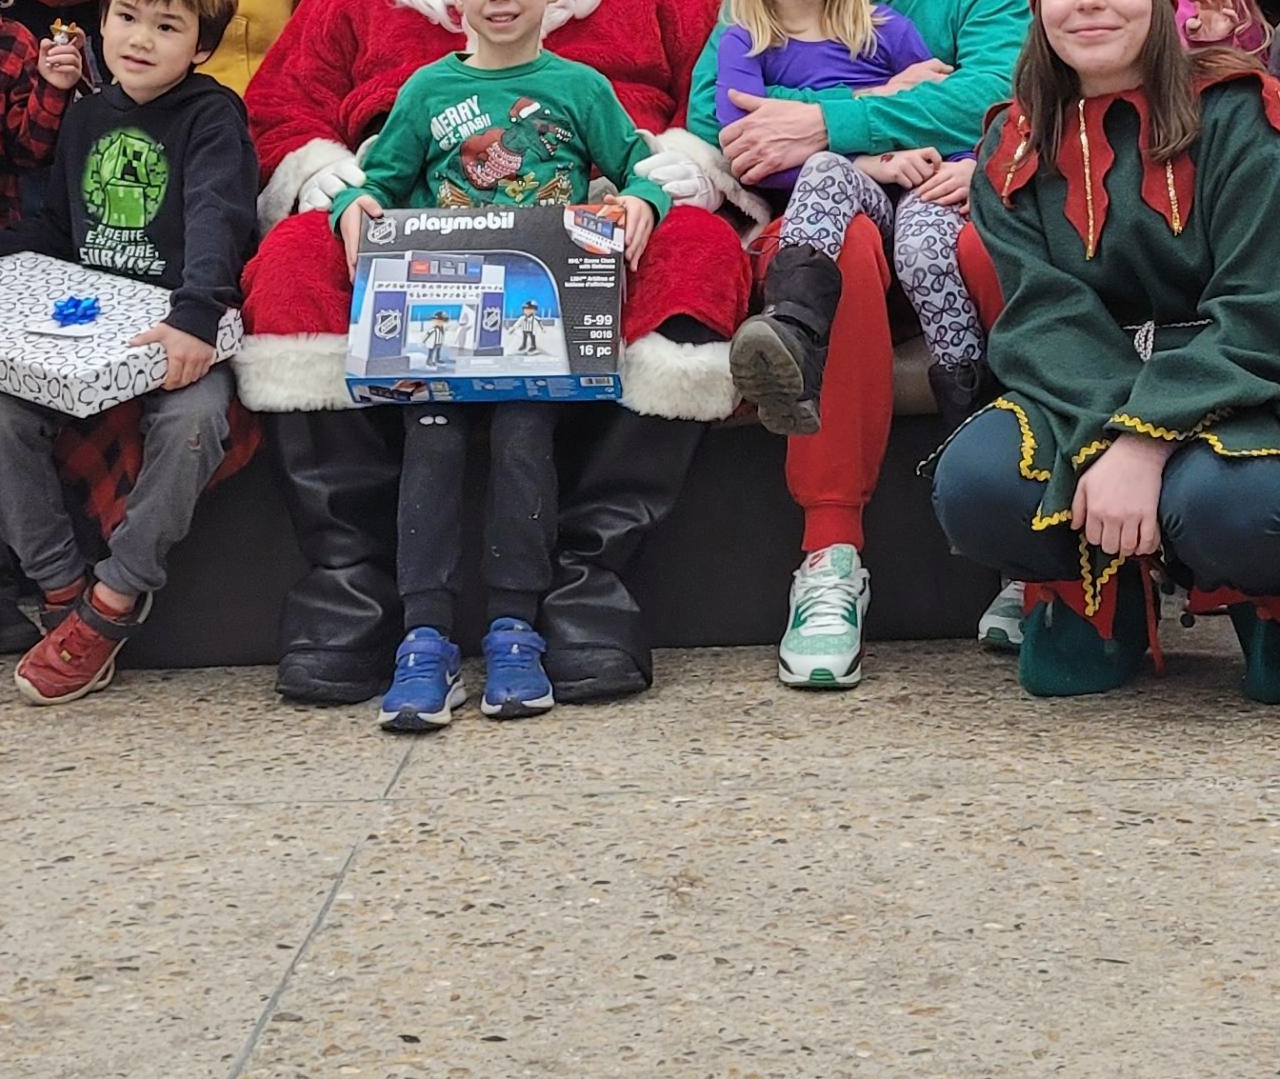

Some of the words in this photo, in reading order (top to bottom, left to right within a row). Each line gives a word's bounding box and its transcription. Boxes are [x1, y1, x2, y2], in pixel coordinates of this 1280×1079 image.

[404, 211, 515, 235] playmobil
[583, 314, 613, 326] 5-99
[579, 344, 594, 356] 16
[596, 346, 612, 358] pc
